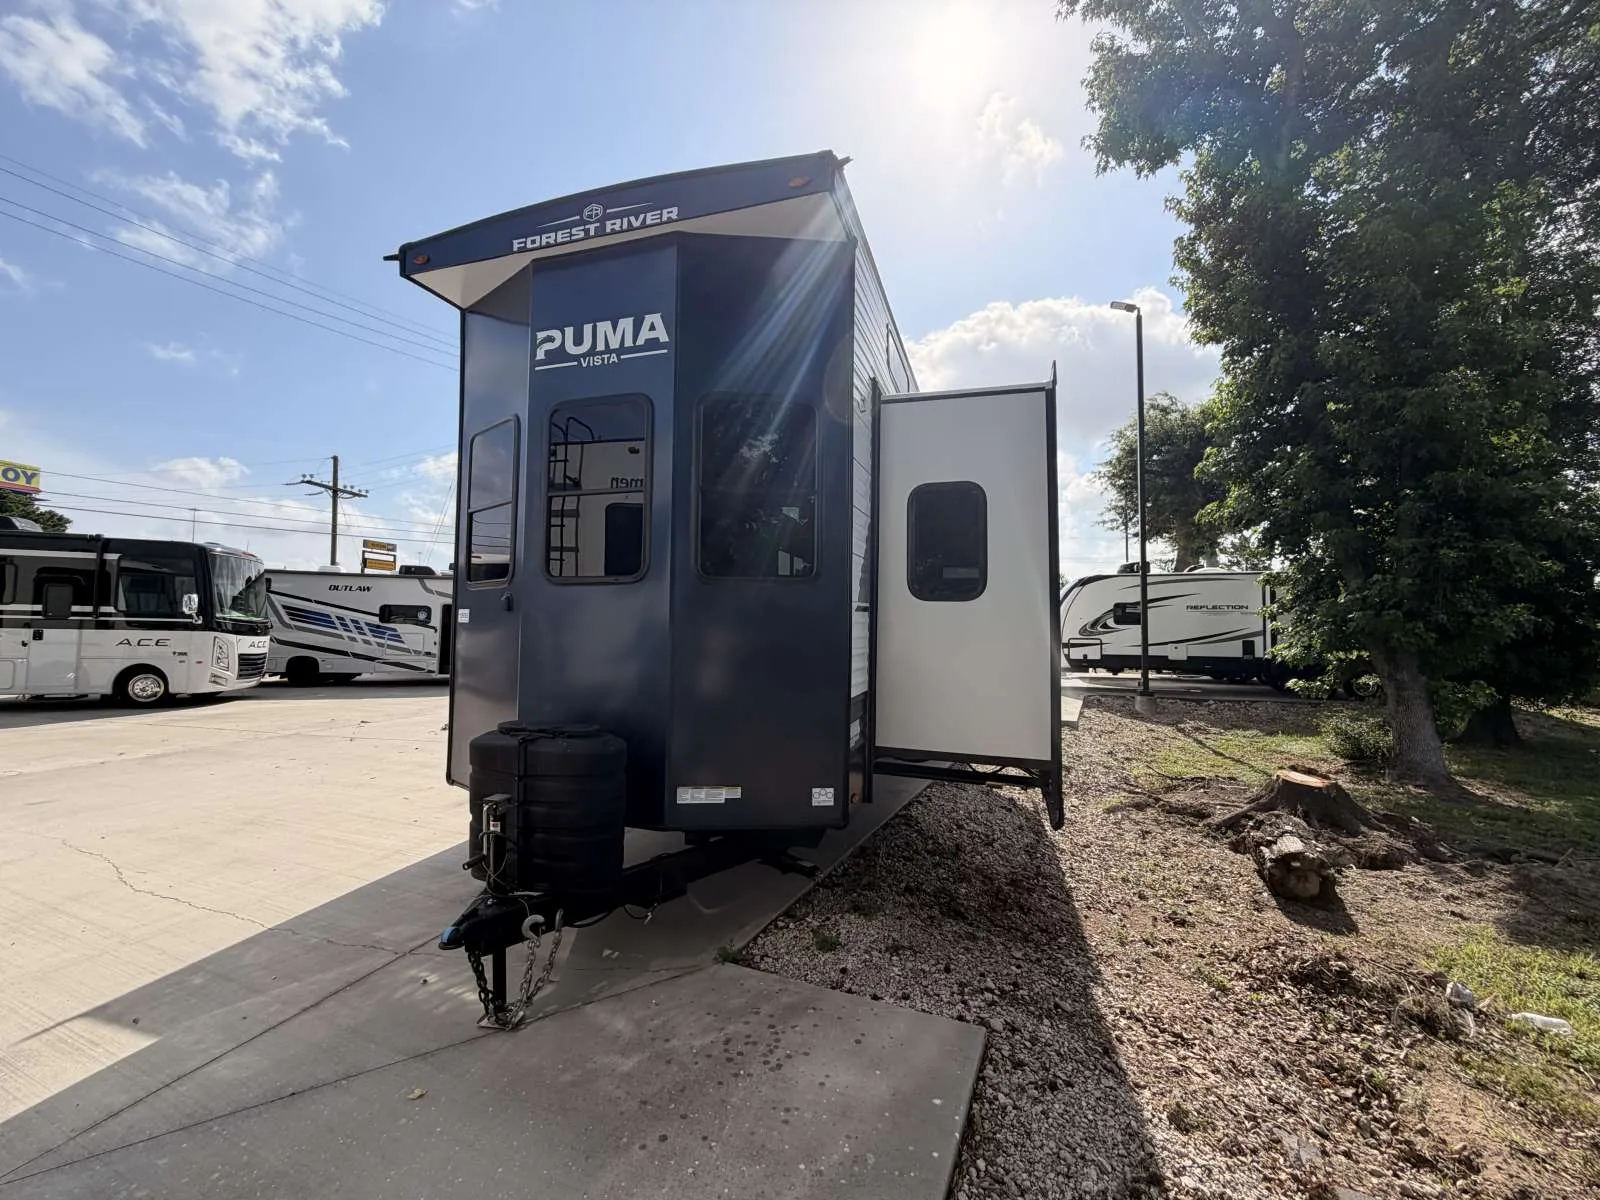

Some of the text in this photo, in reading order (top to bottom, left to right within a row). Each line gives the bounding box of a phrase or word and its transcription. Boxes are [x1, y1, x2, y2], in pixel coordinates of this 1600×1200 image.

[512, 207, 679, 251] FOREST RIVER
[535, 313, 669, 360] PUMA
[580, 353, 618, 367] VISTA
[328, 584, 373, 592] OUTLAW
